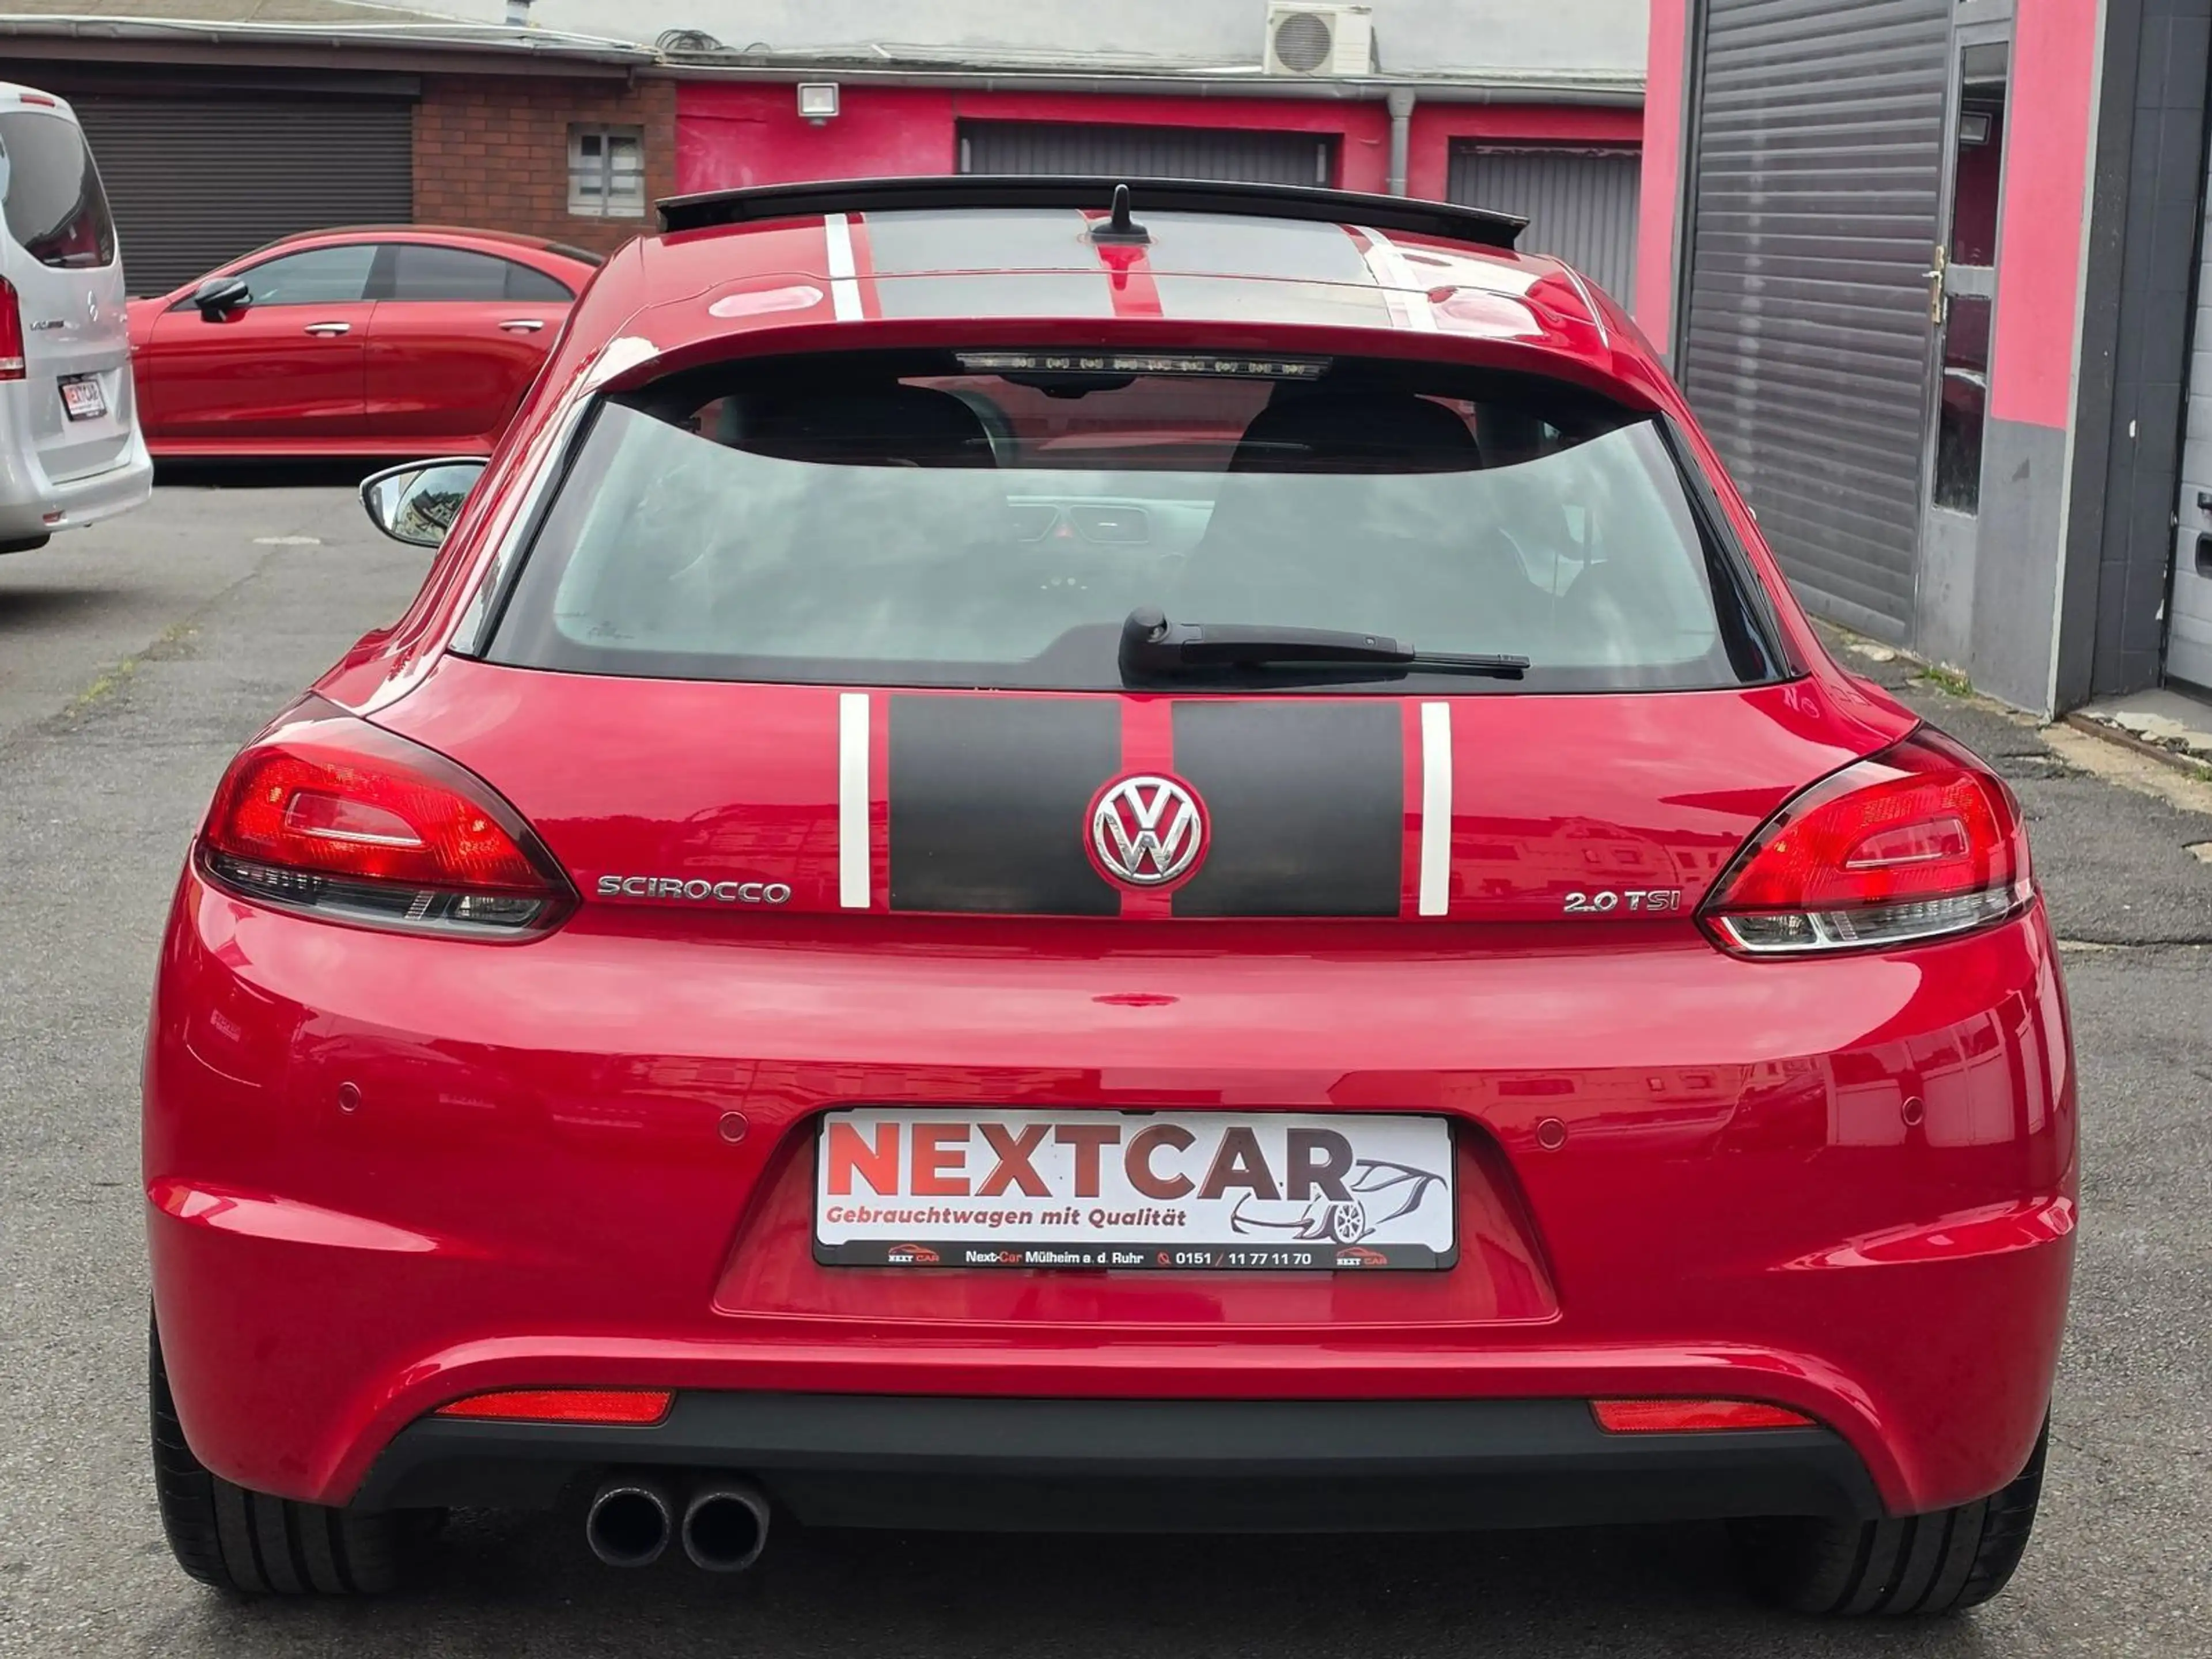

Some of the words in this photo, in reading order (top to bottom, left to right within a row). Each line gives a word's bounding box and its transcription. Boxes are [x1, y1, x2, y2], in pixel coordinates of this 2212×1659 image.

[597, 875, 791, 904] SCIROCCO
[1563, 891, 1618, 912] 2.0
[1624, 890, 1680, 911] TSI
[827, 1122, 1353, 1202] NEXTCAR
[826, 1206, 1033, 1228] Gebrauchtwagen
[1040, 1206, 1081, 1225] mit
[1088, 1207, 1187, 1229] Qualität
[965, 1250, 1022, 1263] Next-Car
[1025, 1251, 1080, 1264] Mülheim
[1112, 1252, 1144, 1264] Ruhr
[1176, 1252, 1211, 1264] 0151
[1229, 1253, 1245, 1265] 11
[1249, 1253, 1268, 1266] 77
[1271, 1253, 1289, 1266] 11
[1293, 1253, 1312, 1266] 70
